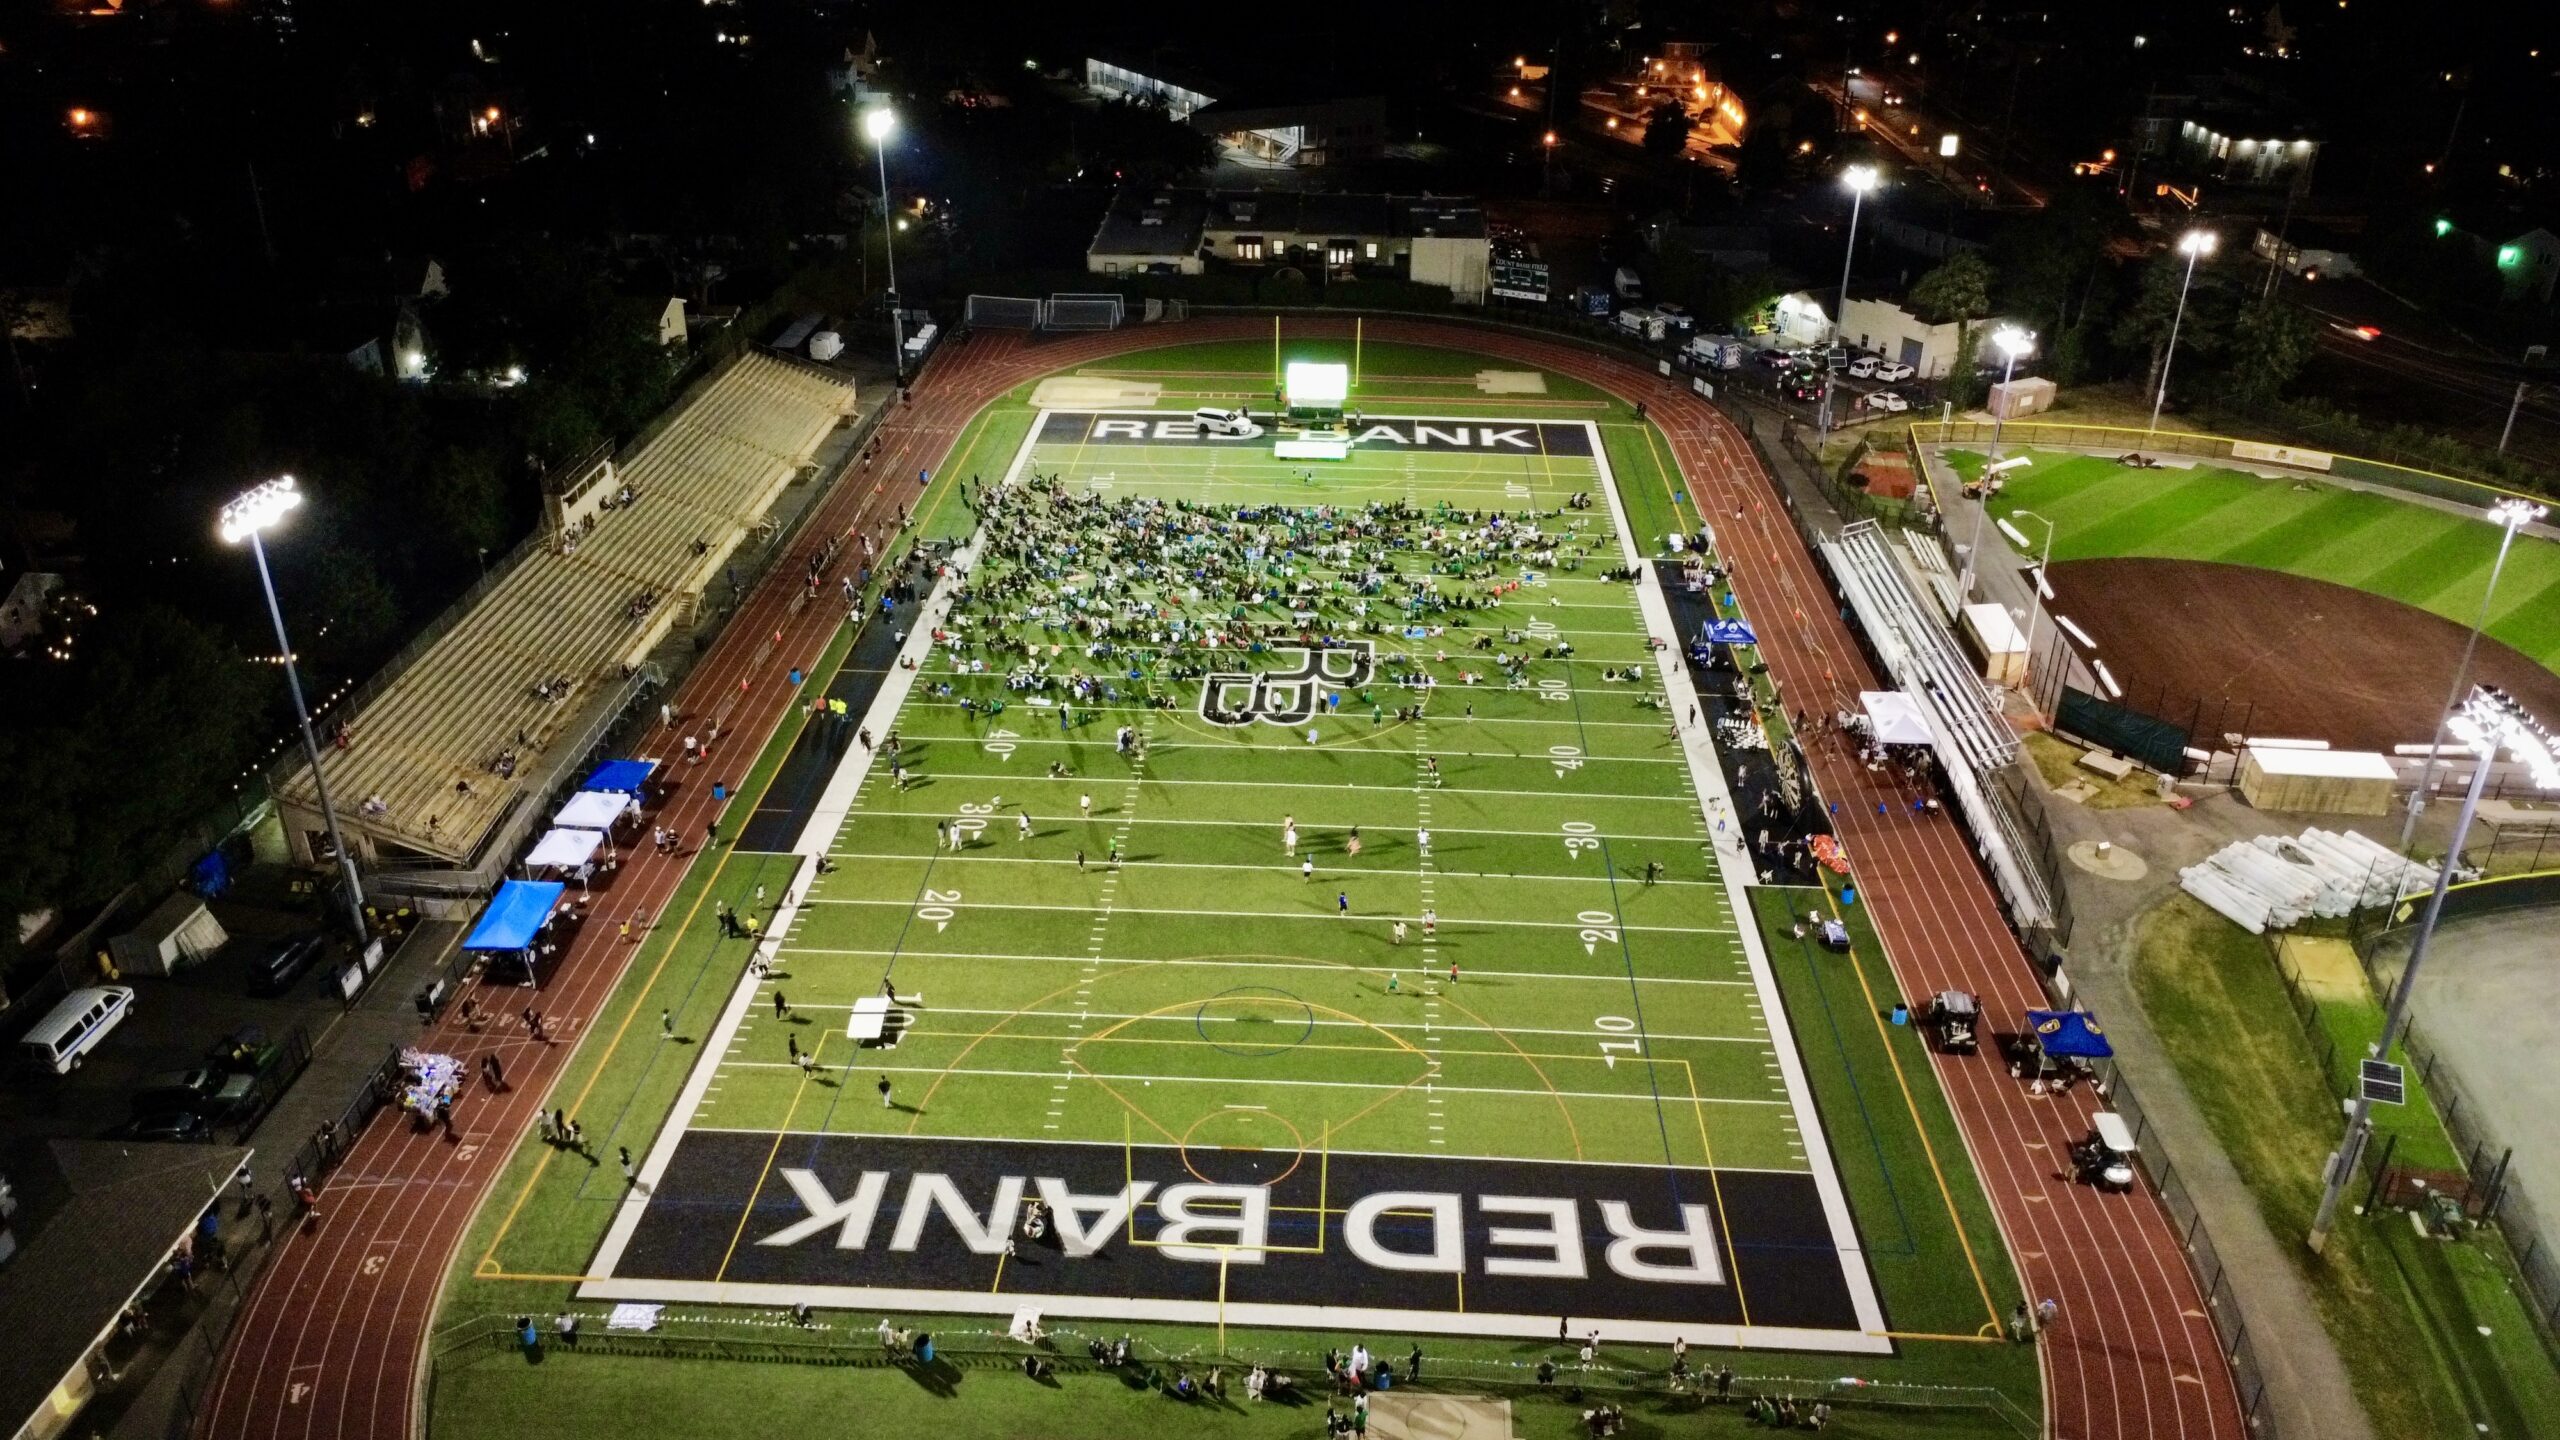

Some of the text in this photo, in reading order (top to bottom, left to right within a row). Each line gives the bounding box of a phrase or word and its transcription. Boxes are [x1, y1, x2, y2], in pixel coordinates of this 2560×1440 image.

[1538, 679, 1569, 700] 50
[984, 729, 1021, 753] 40
[1549, 745, 1583, 770] 40
[1562, 821, 1600, 849] 30
[917, 888, 962, 920] 20
[1576, 910, 1619, 943] 20
[1594, 1015, 1641, 1054] 10
[753, 1167, 1727, 1285] RED BANK
